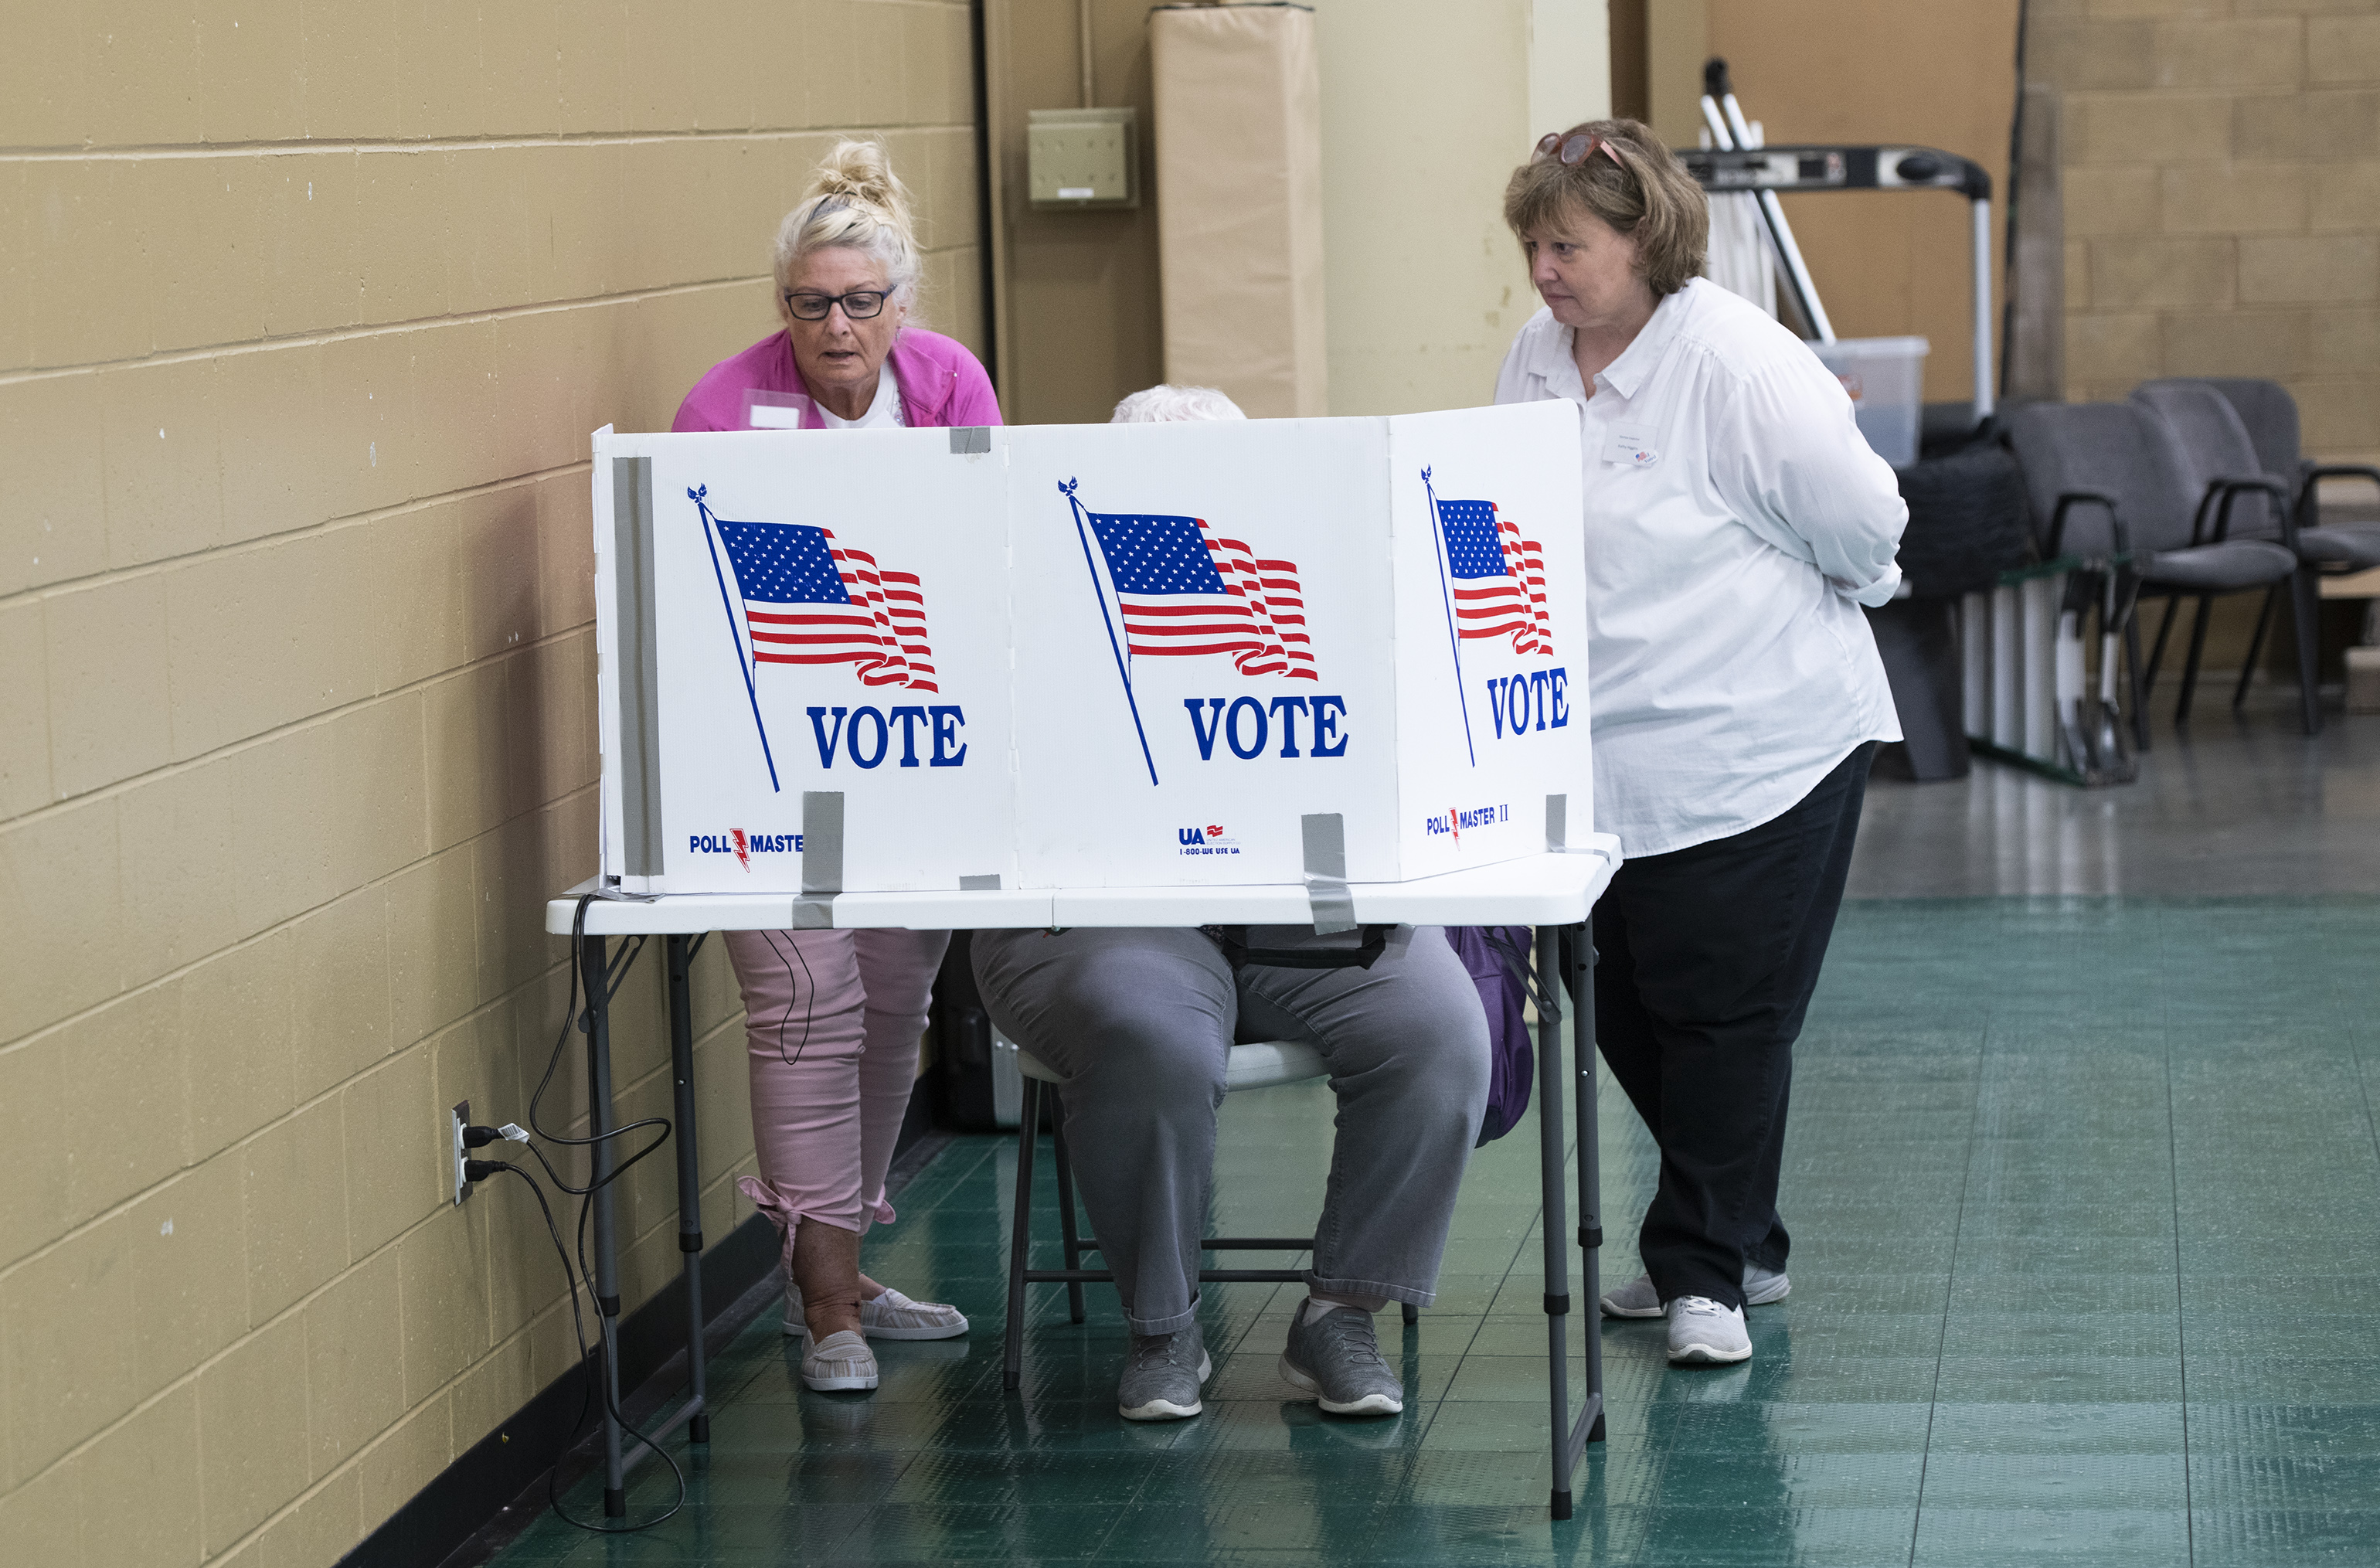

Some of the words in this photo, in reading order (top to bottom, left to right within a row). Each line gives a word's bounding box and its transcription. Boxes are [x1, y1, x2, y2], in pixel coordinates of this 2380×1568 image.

[1487, 667, 1569, 740] VOTE
[806, 706, 967, 769] VOTE
[1184, 696, 1349, 760] VOTE
[1178, 828, 1205, 845] UA
[1427, 815, 1450, 835] POLL
[1460, 807, 1495, 829] MASTER
[690, 835, 731, 853] POLL
[750, 835, 803, 852] MASTE
